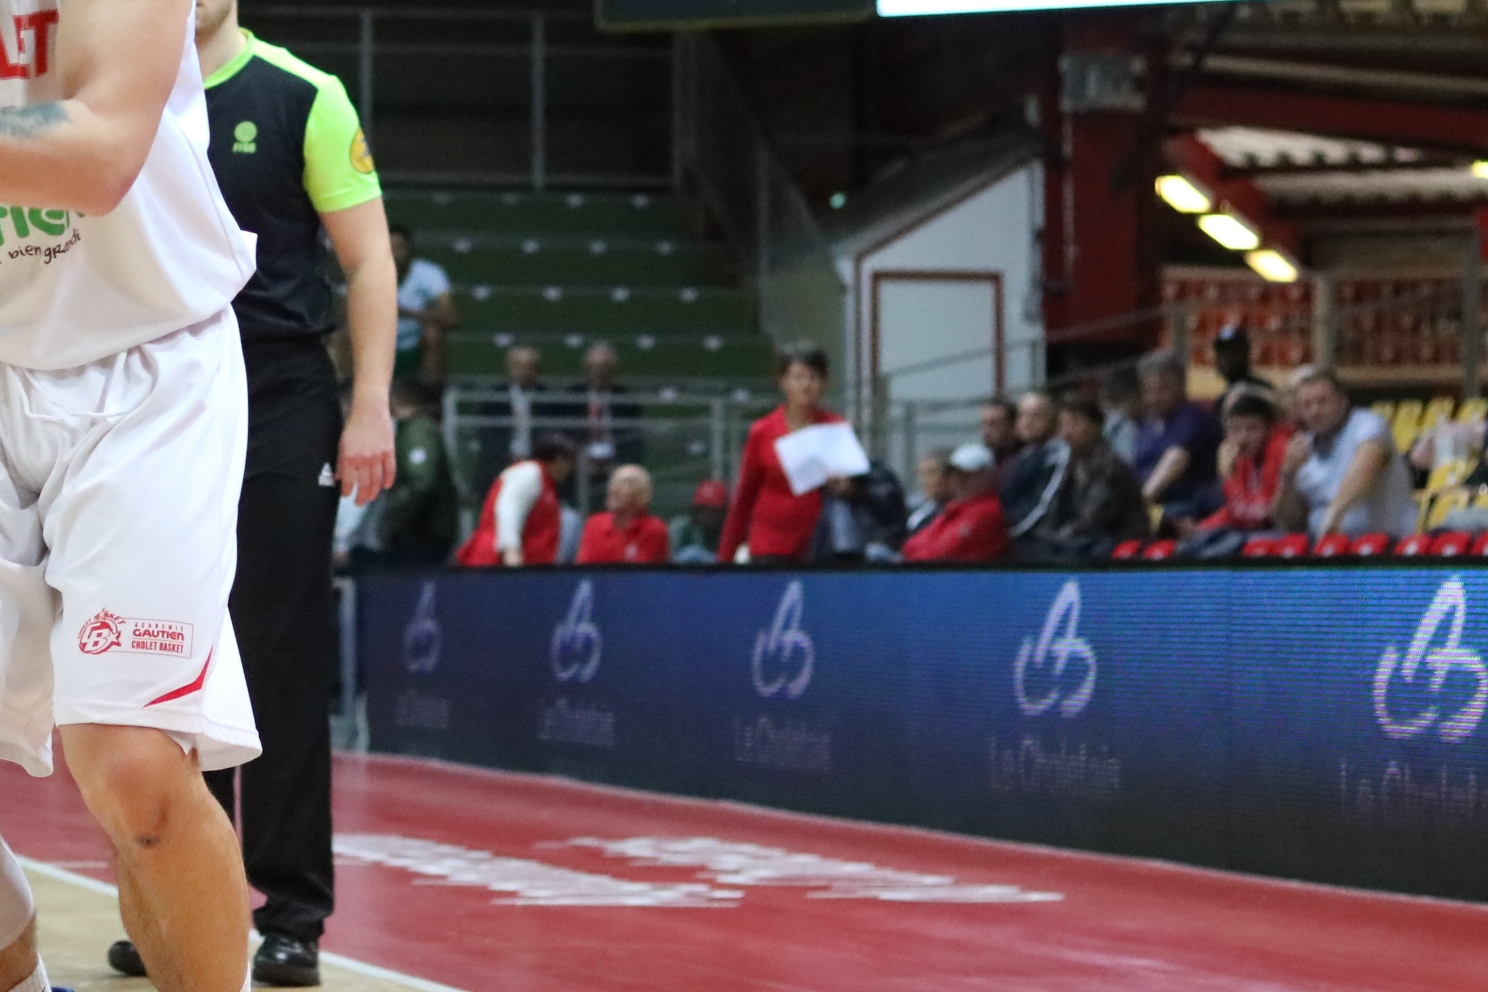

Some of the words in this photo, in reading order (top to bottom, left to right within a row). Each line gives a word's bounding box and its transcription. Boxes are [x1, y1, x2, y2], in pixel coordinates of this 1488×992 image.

[132, 628, 185, 641] GAUTIER
[131, 640, 158, 652] CHOLET
[159, 641, 185, 654] BASKET
